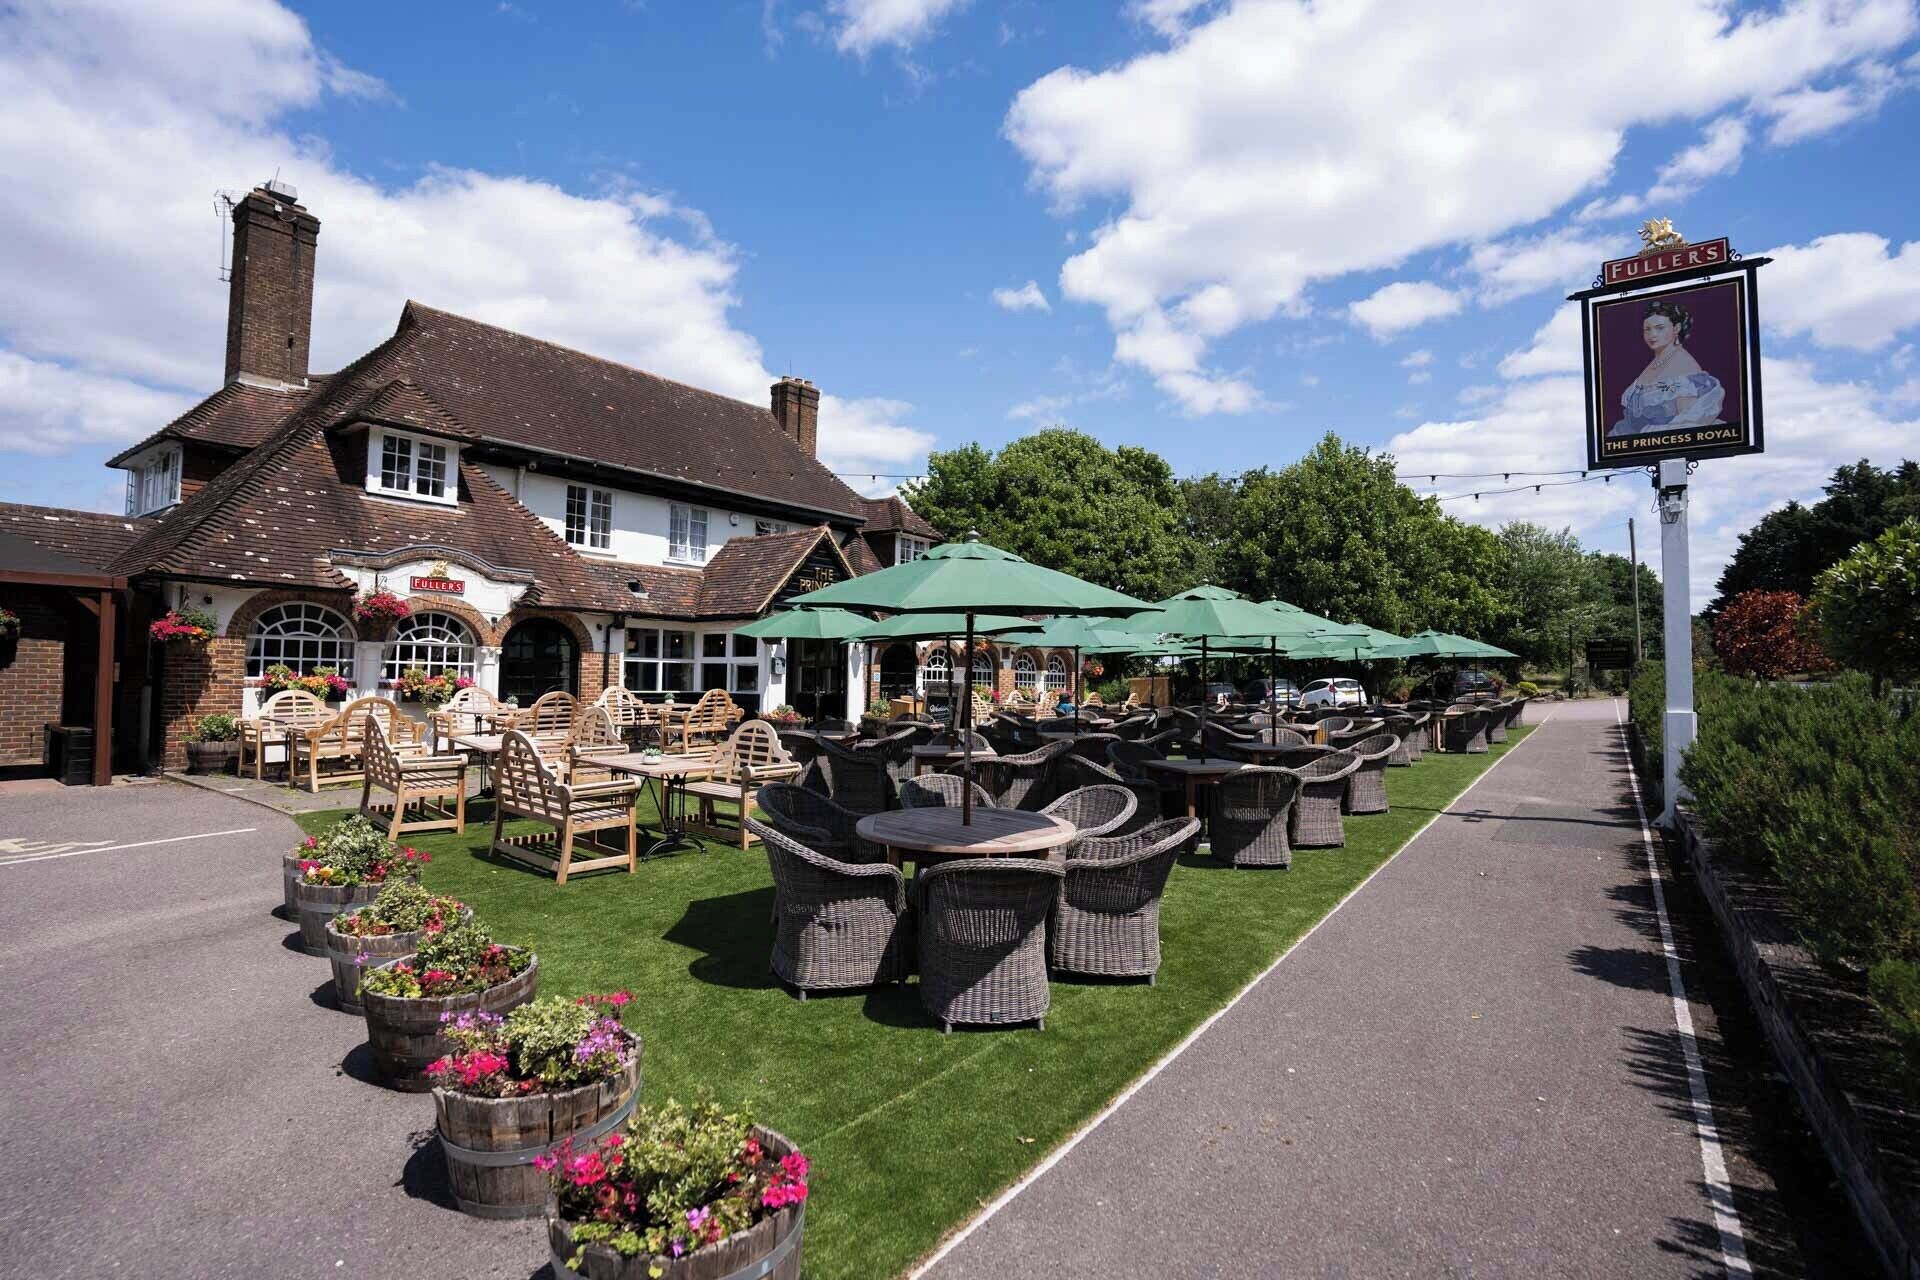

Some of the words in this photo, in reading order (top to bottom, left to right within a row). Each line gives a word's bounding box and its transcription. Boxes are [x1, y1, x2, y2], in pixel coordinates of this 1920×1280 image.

[1611, 245, 1719, 279] FULLER'S
[1605, 440, 1628, 451] THE
[1633, 433, 1692, 448] PRINCESS
[1696, 428, 1739, 441] ROYAL
[814, 567, 834, 581] THE
[414, 578, 462, 591] FULLER'S
[799, 578, 832, 593] PRIN
